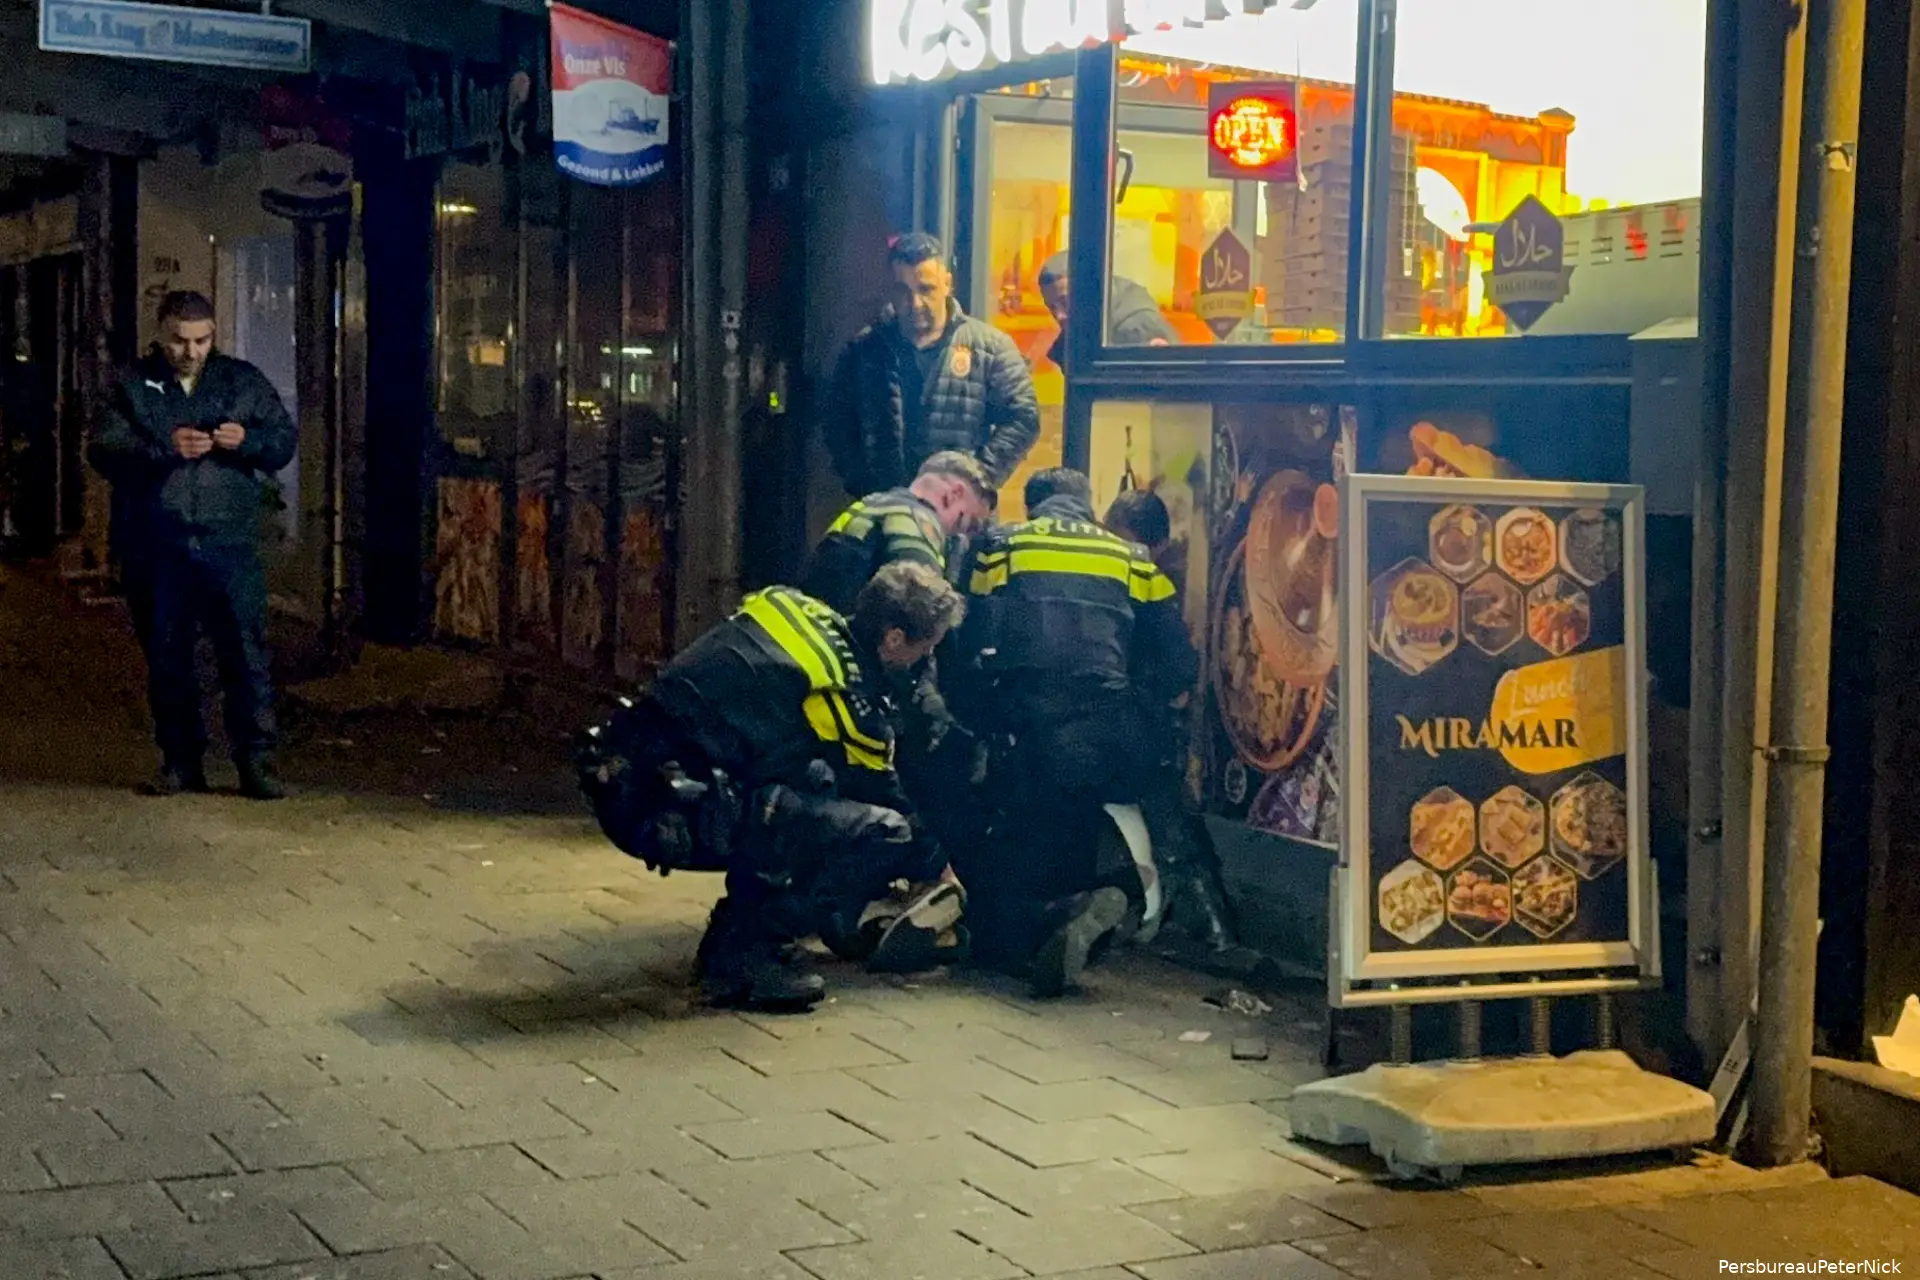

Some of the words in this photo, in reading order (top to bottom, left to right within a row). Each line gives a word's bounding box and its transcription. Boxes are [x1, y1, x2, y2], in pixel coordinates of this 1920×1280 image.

[564, 53, 601, 75] Onze
[1214, 112, 1286, 150] OPEN
[557, 154, 609, 181] Gezond
[611, 167, 622, 181] &
[624, 159, 665, 181] Lekker
[1395, 714, 1578, 758] MIRAMAR
